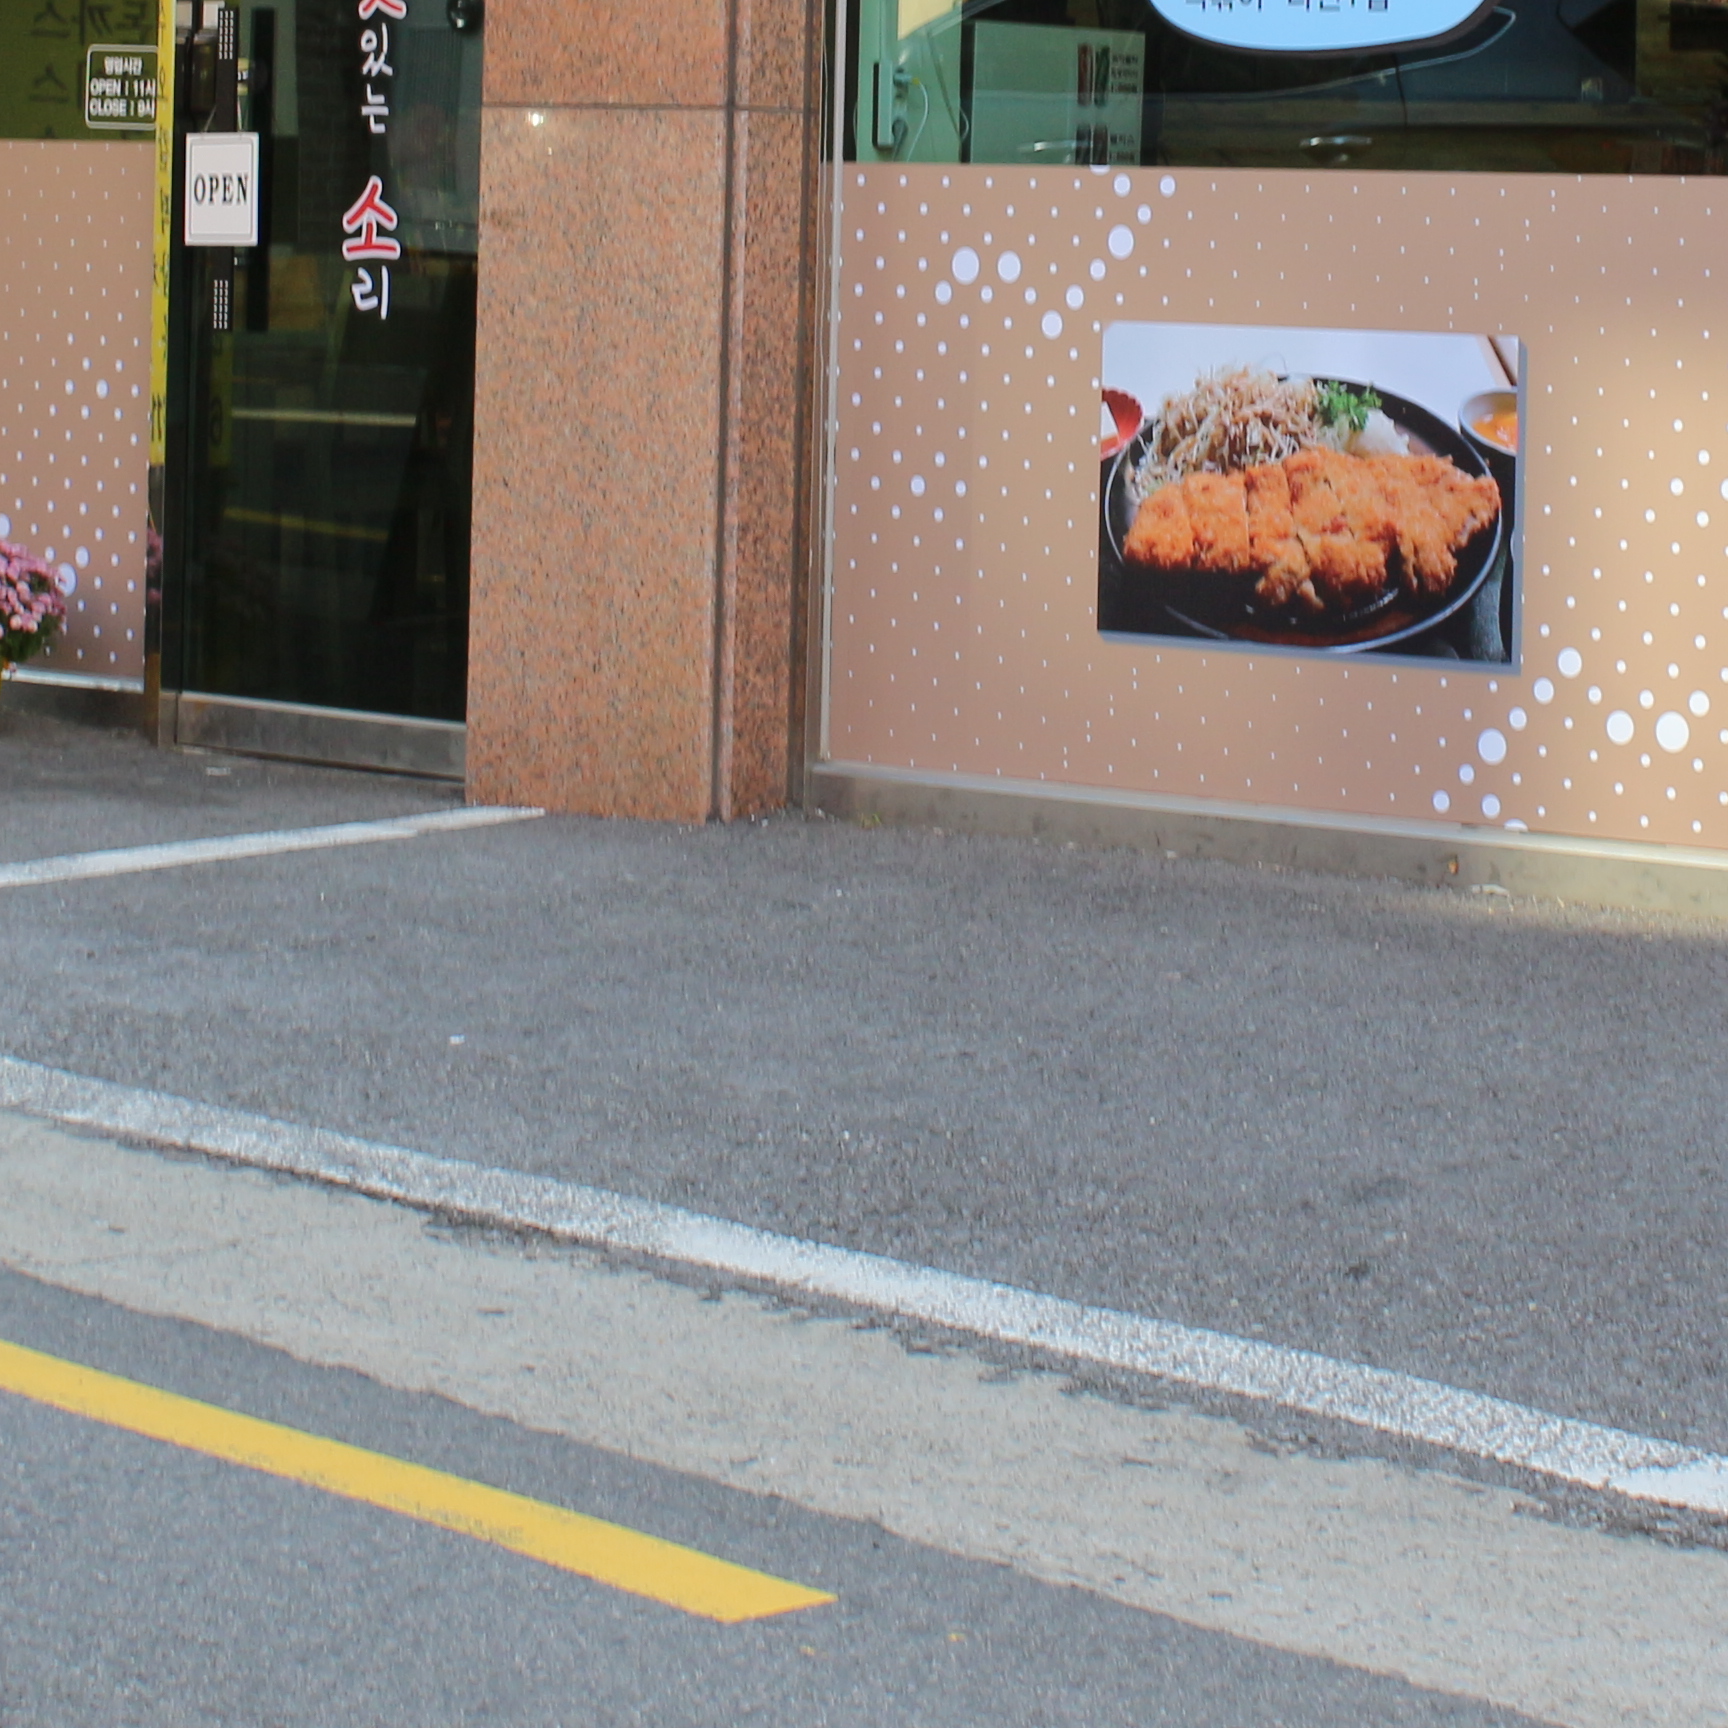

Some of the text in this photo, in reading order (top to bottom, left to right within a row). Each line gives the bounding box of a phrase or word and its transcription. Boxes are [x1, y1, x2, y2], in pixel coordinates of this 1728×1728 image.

[90, 77, 122, 97] OPEN
[89, 97, 128, 117] CLOSE
[192, 173, 250, 207] OPEN
[342, 174, 402, 321] 소리
